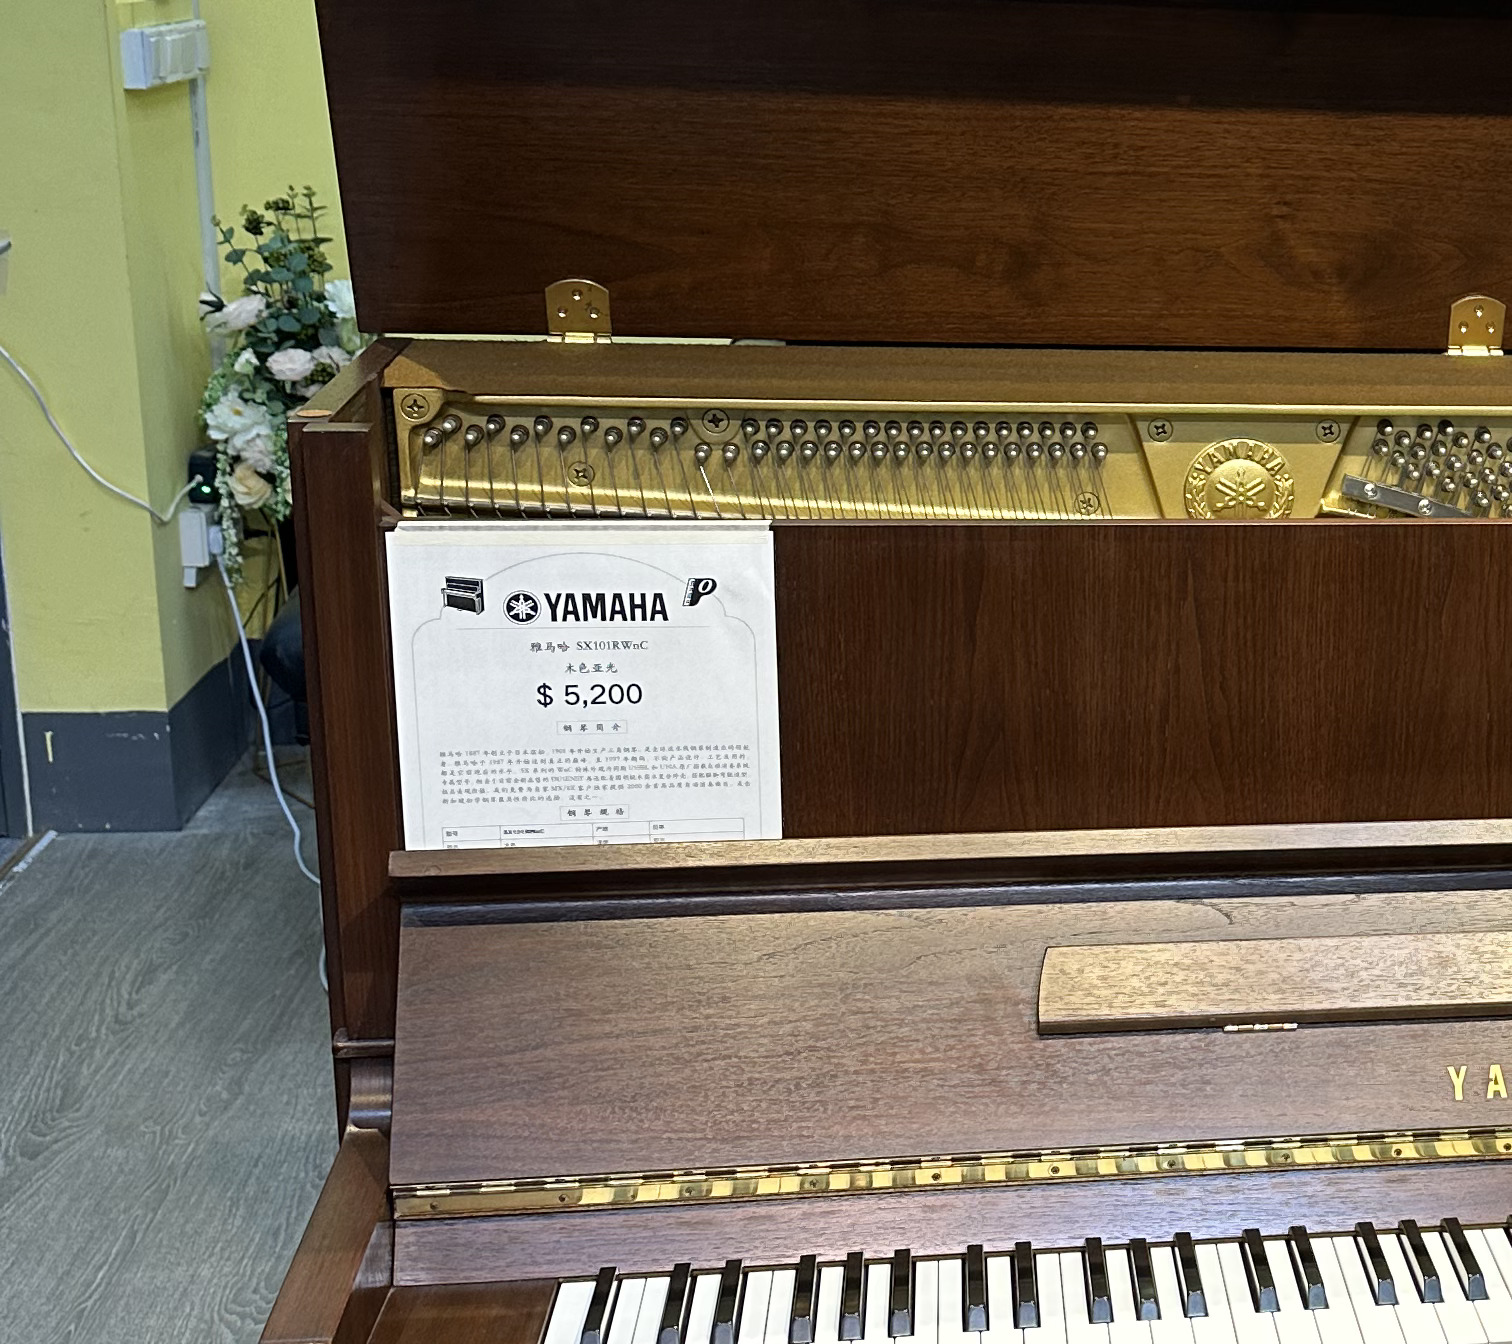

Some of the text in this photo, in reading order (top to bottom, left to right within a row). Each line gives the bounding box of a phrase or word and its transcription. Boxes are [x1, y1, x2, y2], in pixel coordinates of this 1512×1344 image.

[1193, 440, 1286, 476] YAMAHA
[544, 592, 669, 622] YAMAHA
[529, 640, 649, 654] 雅马哈 SX101RWnC
[564, 662, 619, 674] 木色亚光
[536, 682, 643, 709] $ 5,200
